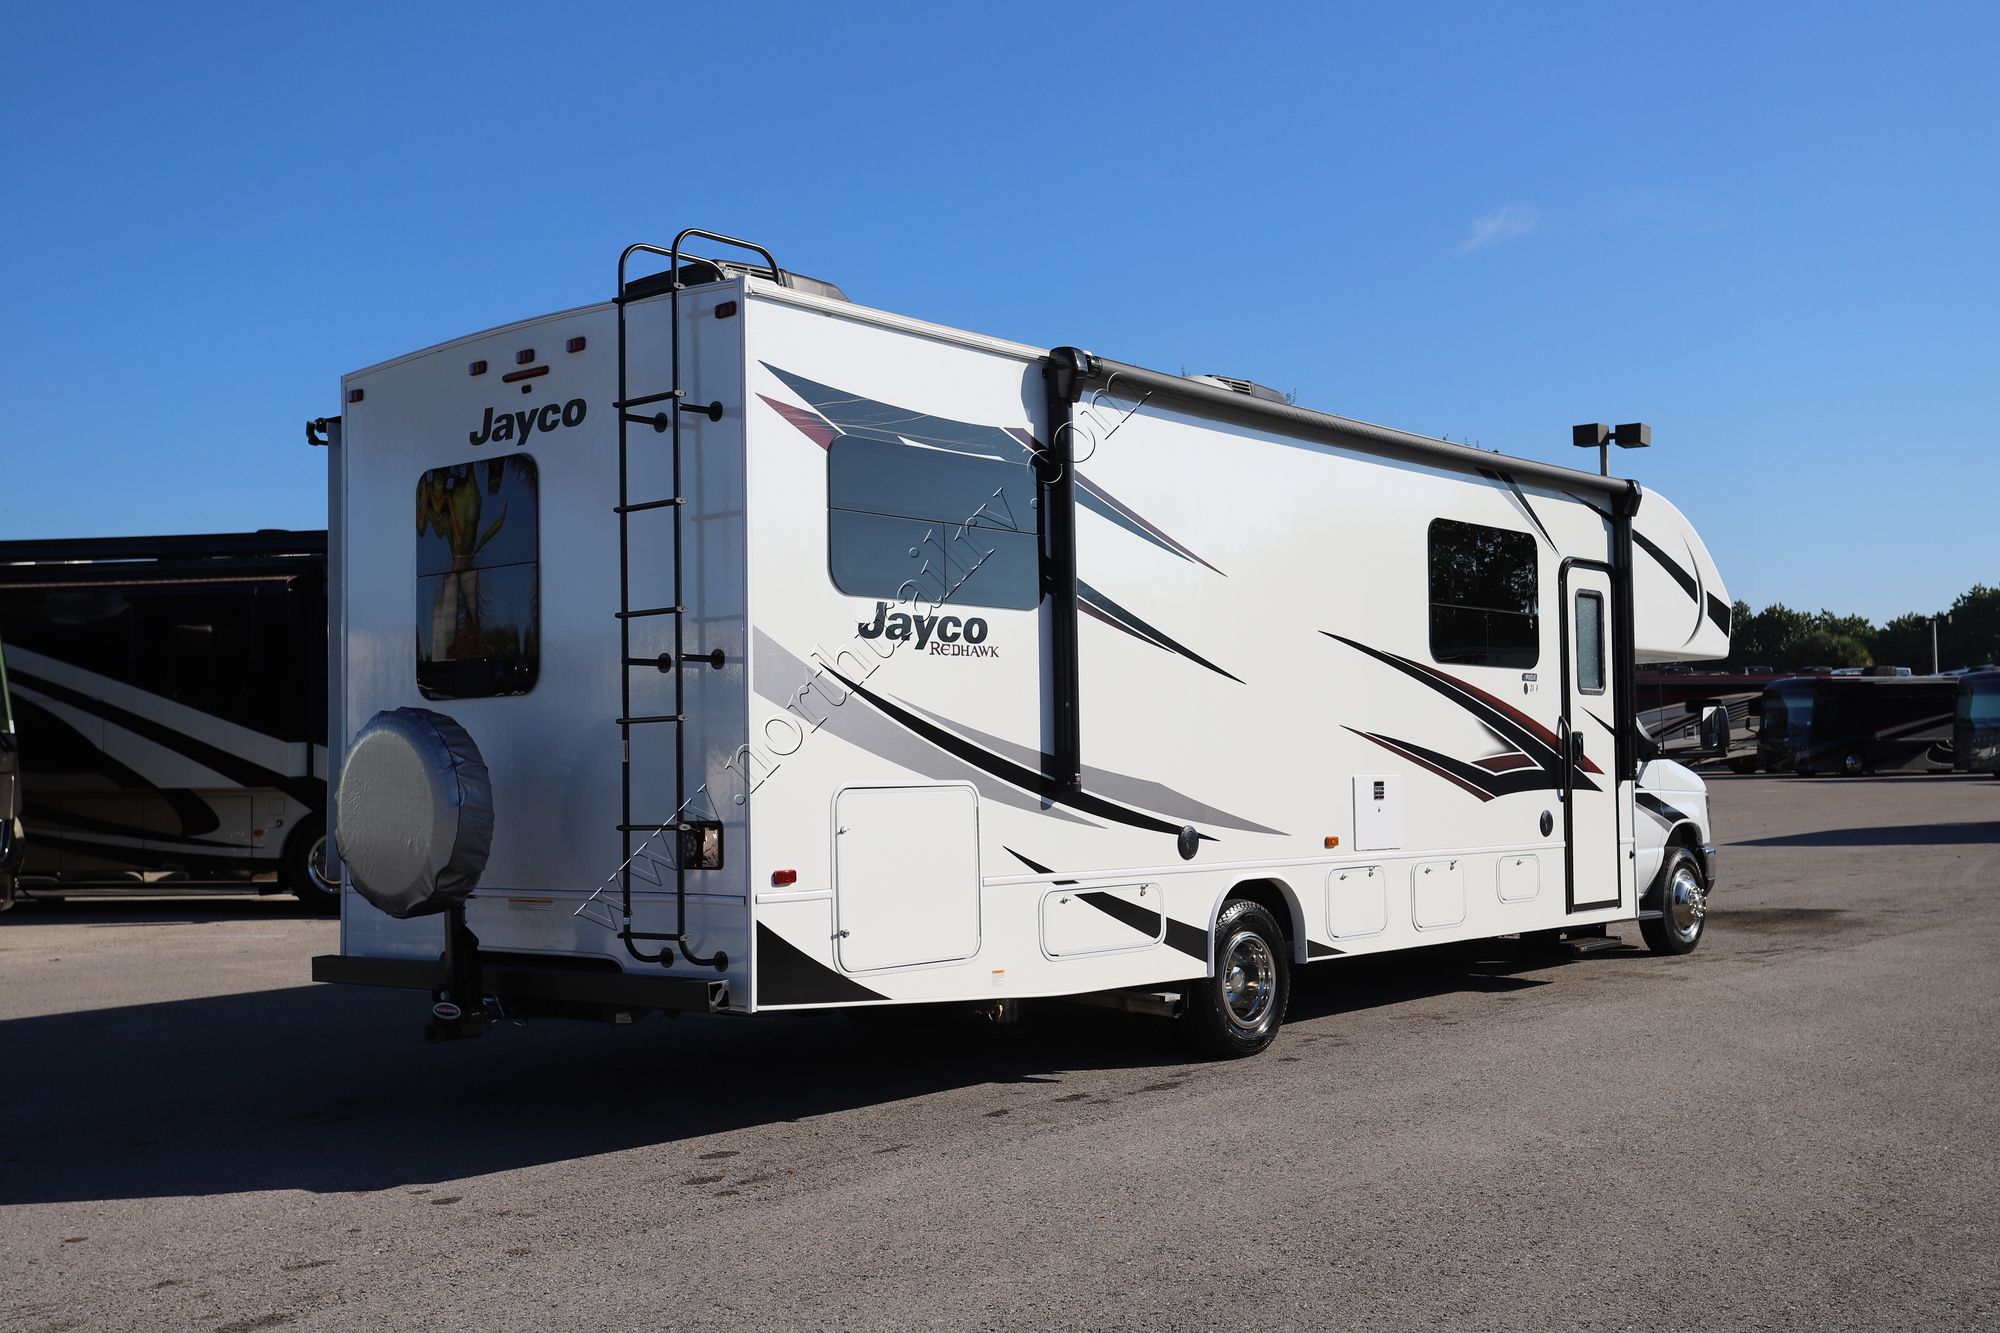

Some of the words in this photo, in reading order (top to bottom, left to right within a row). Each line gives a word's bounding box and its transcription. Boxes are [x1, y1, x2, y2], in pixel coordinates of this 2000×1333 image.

[469, 397, 587, 447] Jayco
[858, 601, 988, 650] Jayco
[929, 641, 1000, 658] REDHAWK
